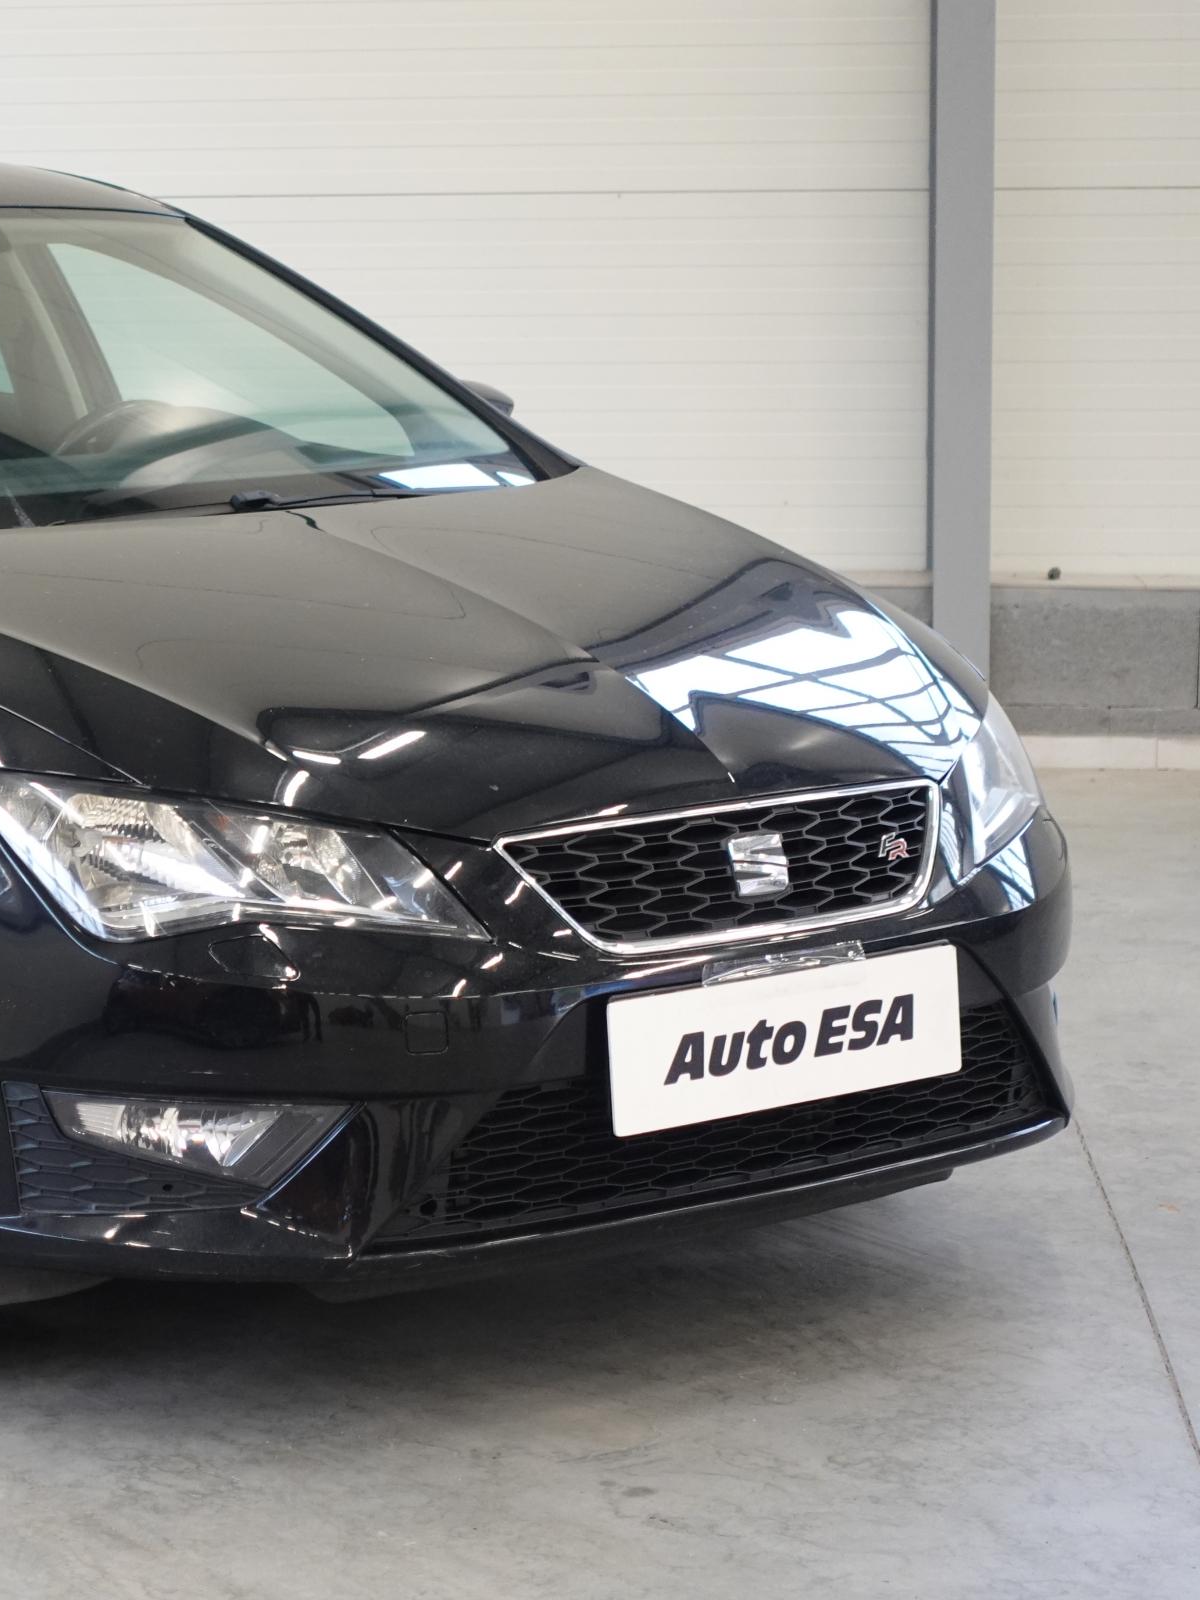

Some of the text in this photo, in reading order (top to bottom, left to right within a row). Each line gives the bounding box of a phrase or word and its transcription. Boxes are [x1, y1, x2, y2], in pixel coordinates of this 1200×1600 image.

[878, 832, 910, 860] FR
[664, 993, 914, 1085] Auto ESA
